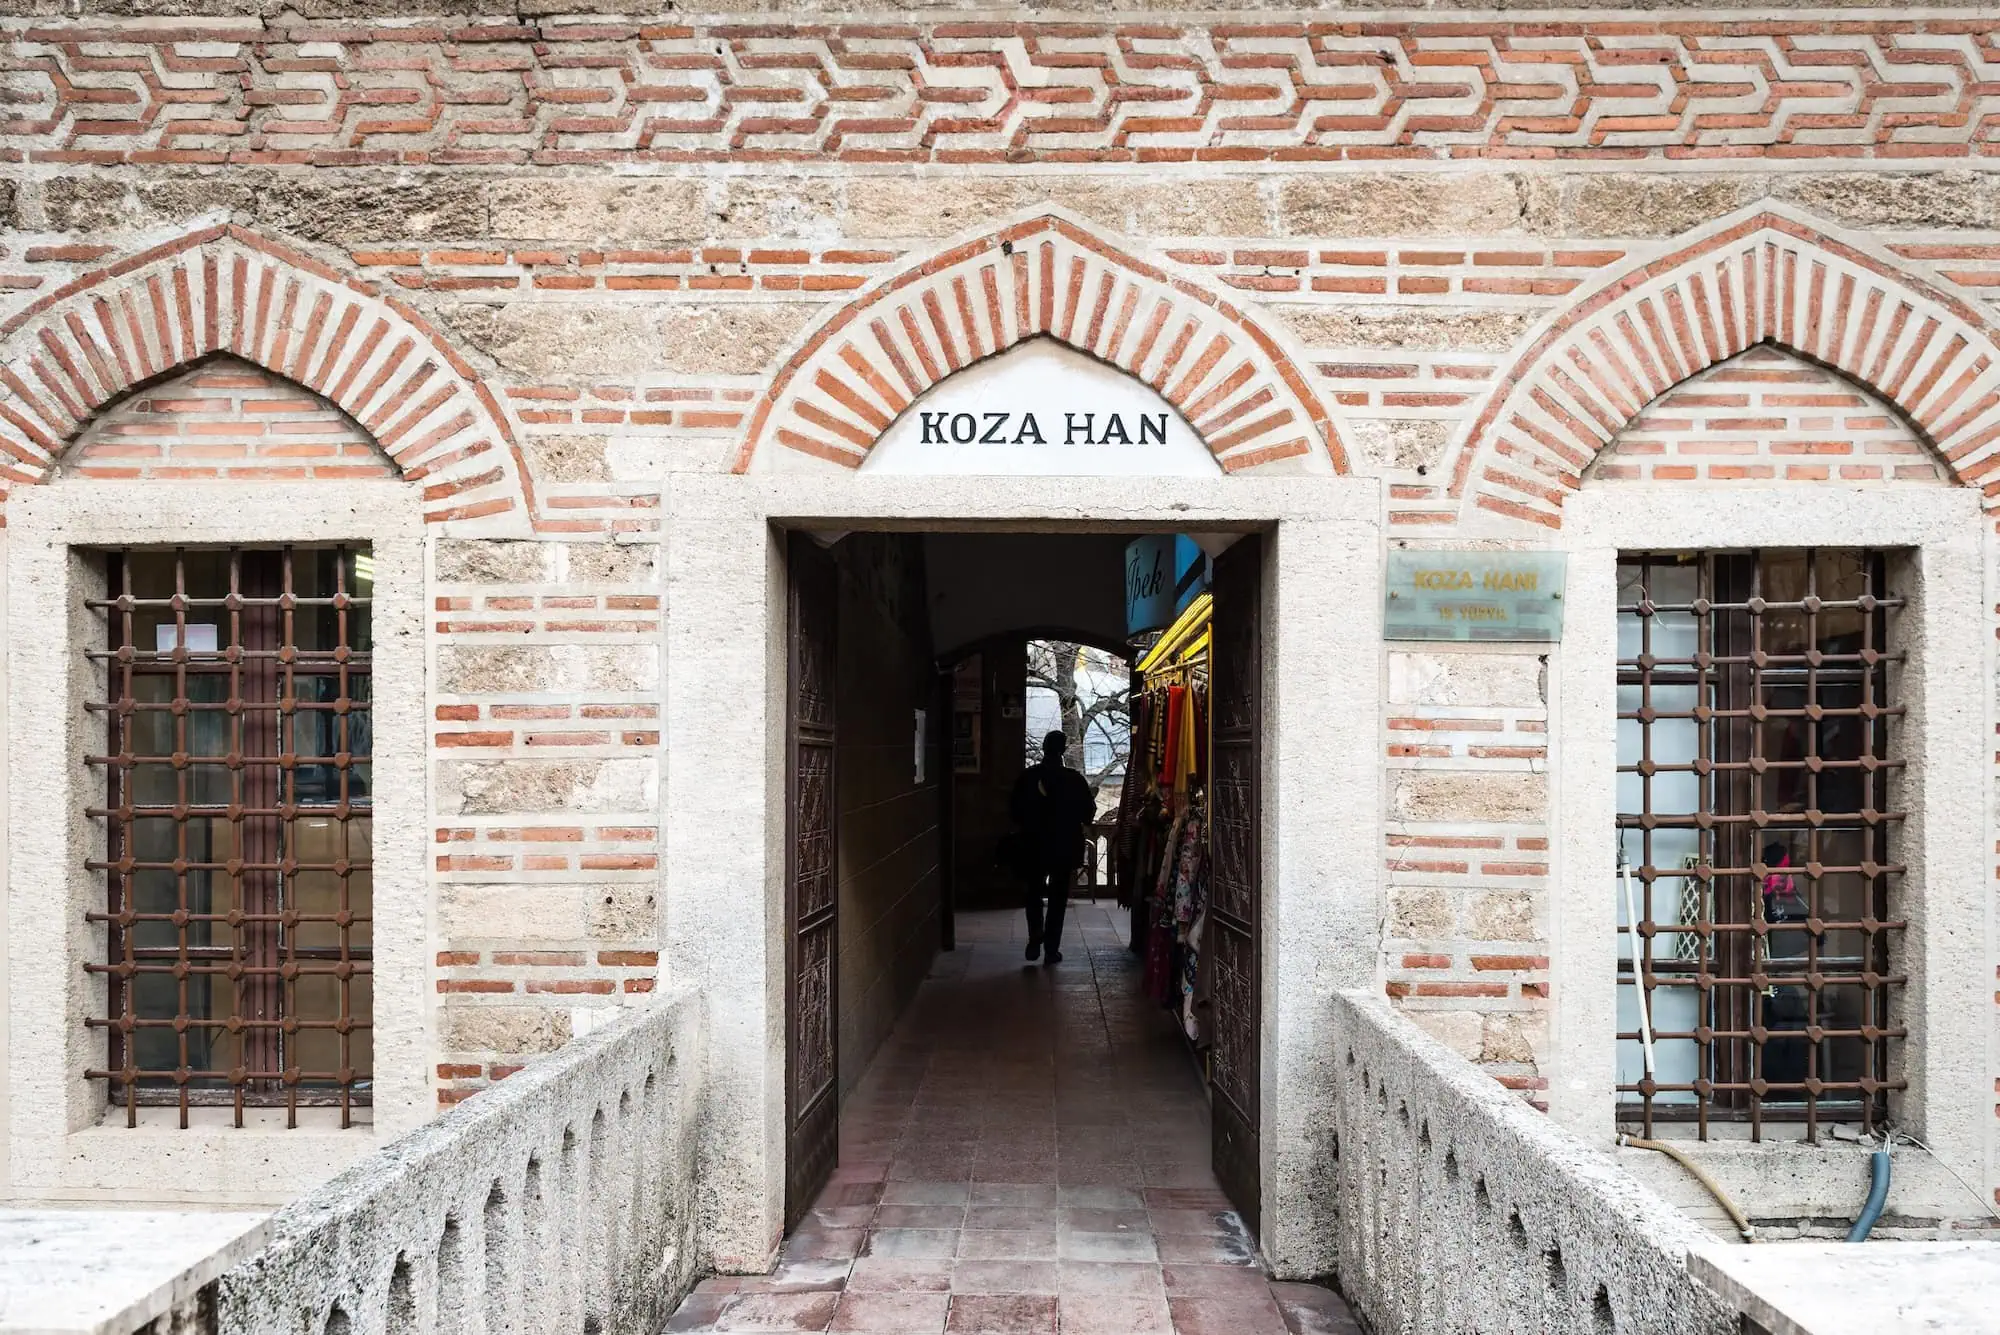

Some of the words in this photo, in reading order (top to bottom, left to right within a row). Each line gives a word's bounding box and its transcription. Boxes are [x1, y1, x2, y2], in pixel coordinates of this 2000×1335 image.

[919, 412, 1047, 445] KOZA
[1063, 412, 1169, 445] HAN
[1414, 570, 1473, 591] KOZA
[1483, 570, 1538, 592] HANI
